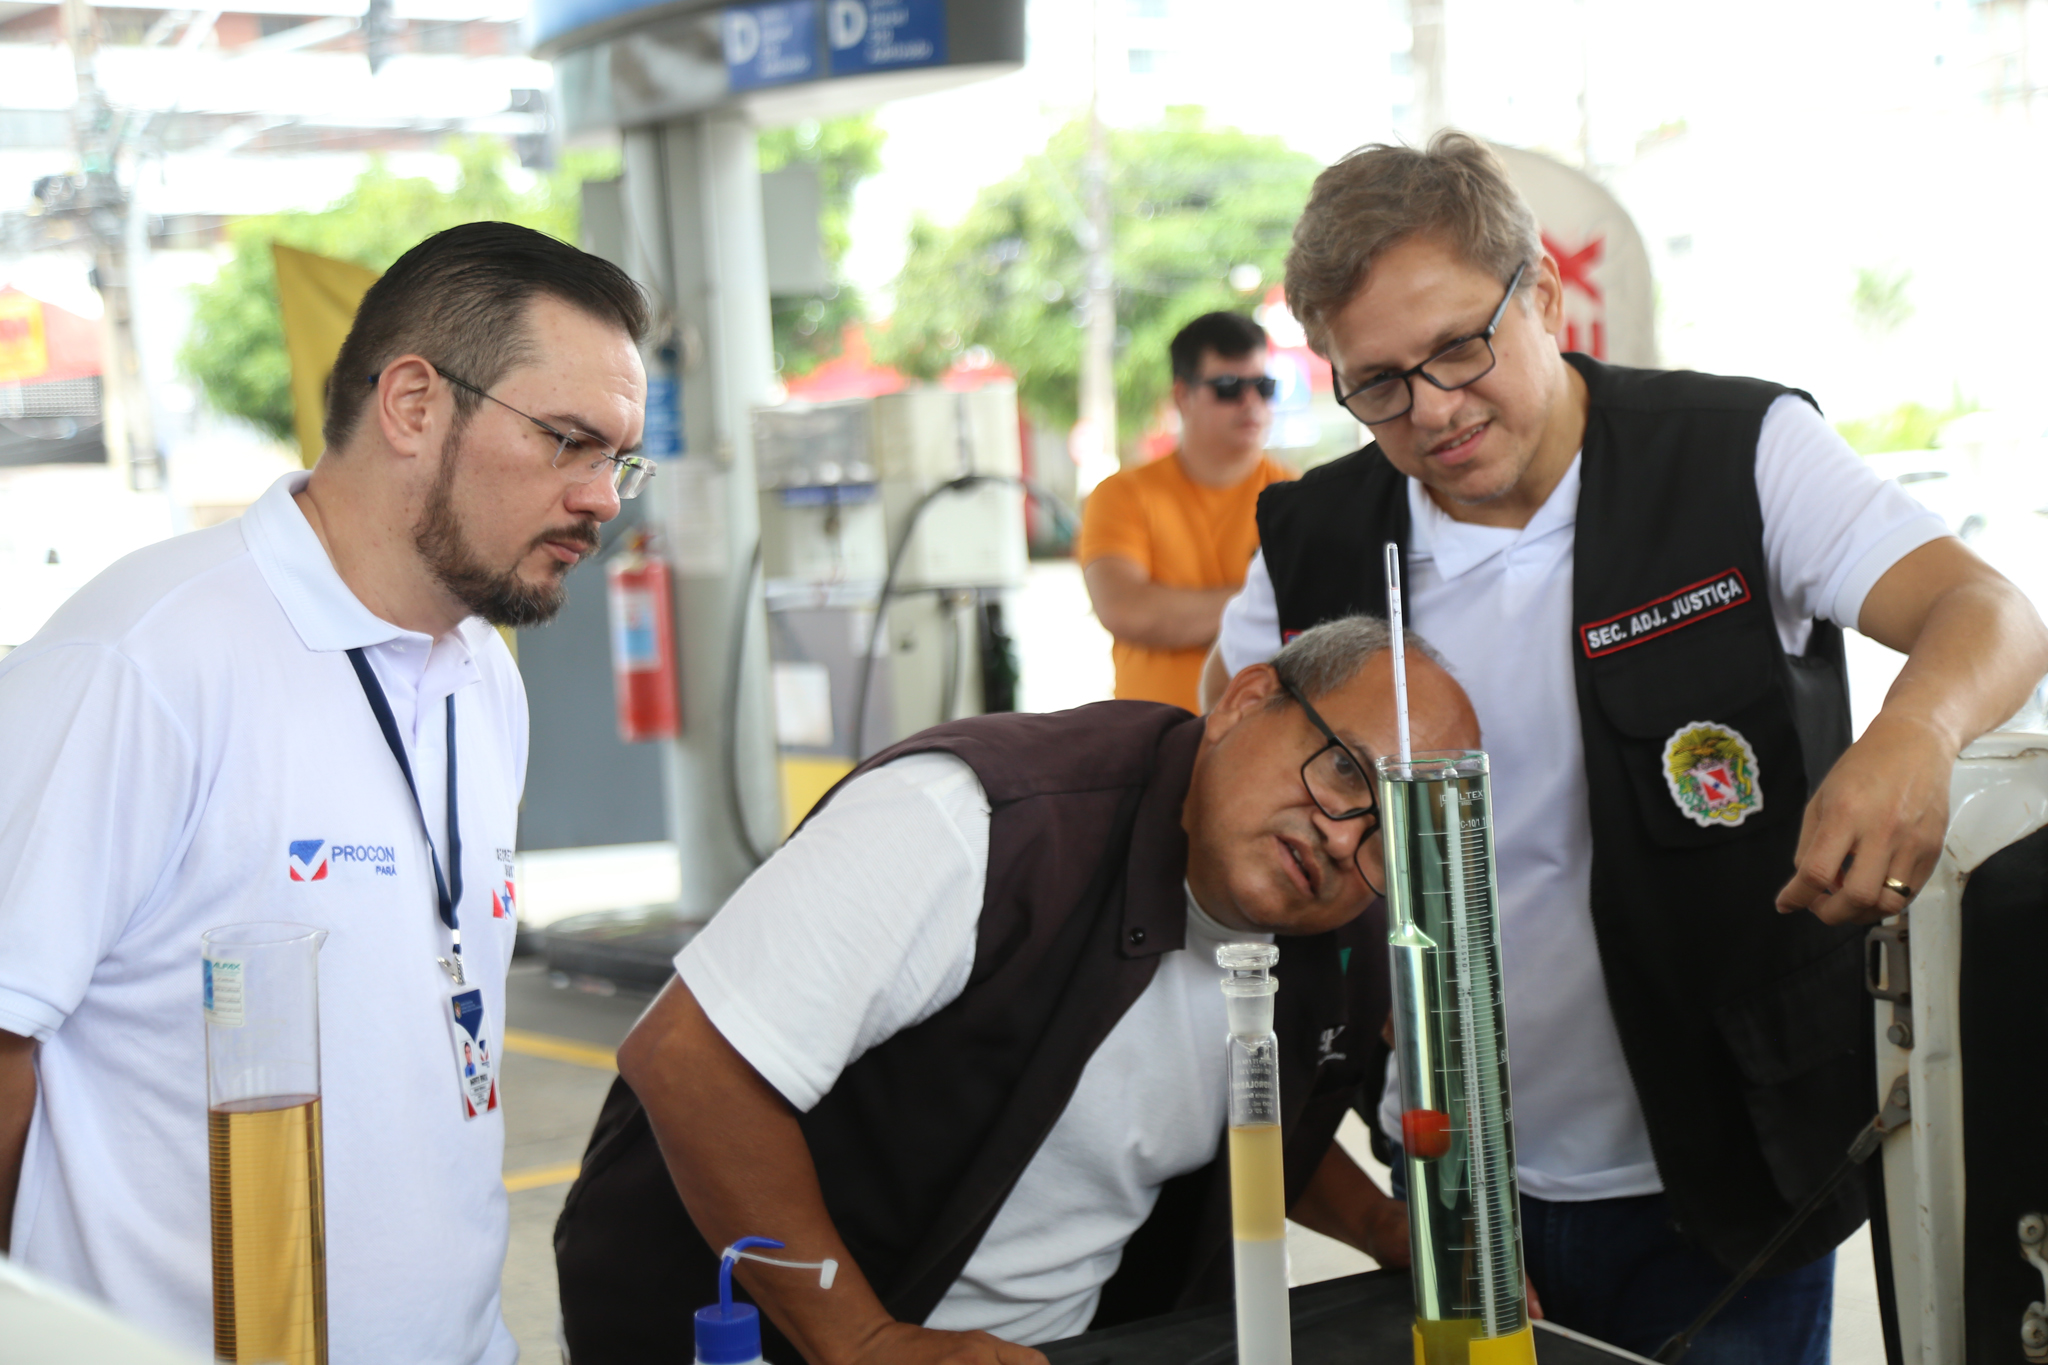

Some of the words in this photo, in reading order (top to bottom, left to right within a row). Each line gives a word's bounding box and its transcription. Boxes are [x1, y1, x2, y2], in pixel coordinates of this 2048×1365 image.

[1586, 623, 1628, 650] SEC.
[1630, 606, 1667, 636] ADJ.
[1670, 576, 1743, 620] JUSTIÇA
[331, 845, 395, 862] PROCON
